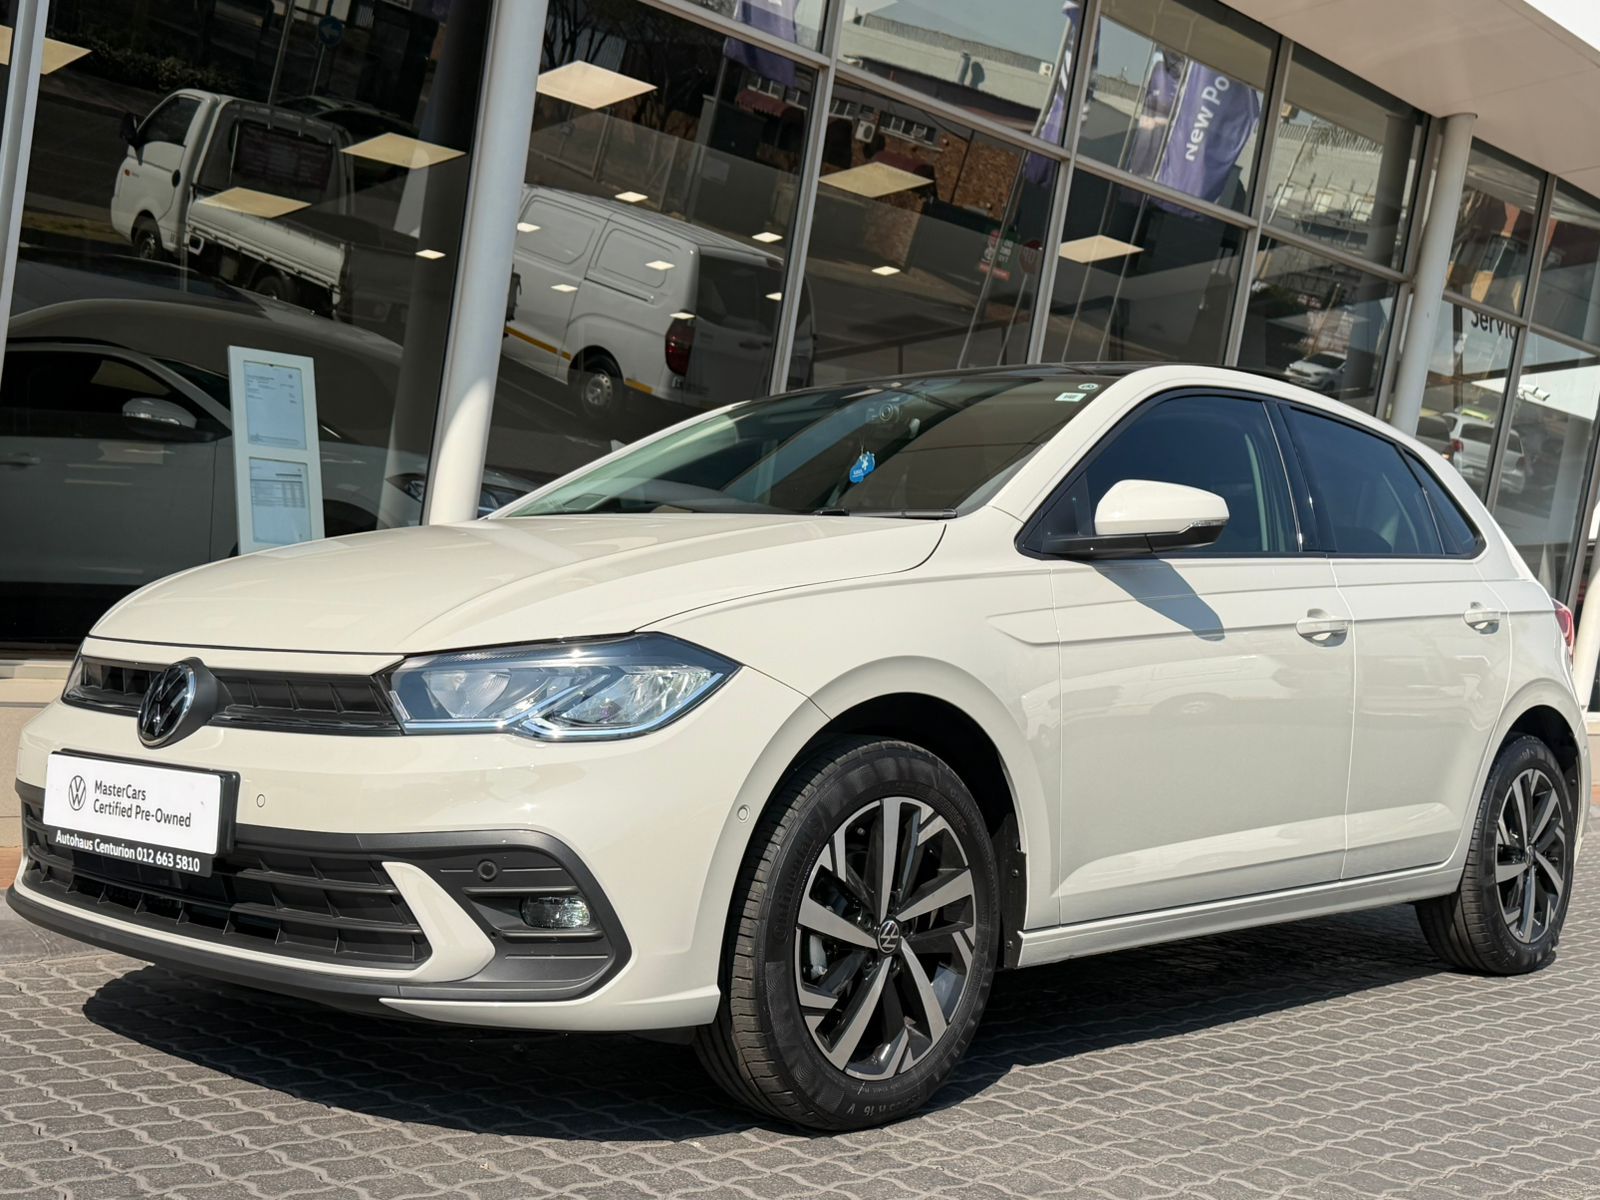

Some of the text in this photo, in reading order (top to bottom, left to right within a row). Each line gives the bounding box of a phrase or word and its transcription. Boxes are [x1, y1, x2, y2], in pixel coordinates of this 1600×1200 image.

[1185, 105, 1214, 161] New
[94, 779, 147, 801] MasterCars
[93, 799, 192, 828] Certified Pre-Owned
[55, 829, 200, 873] Autohaus Centurion 012 663 5810
